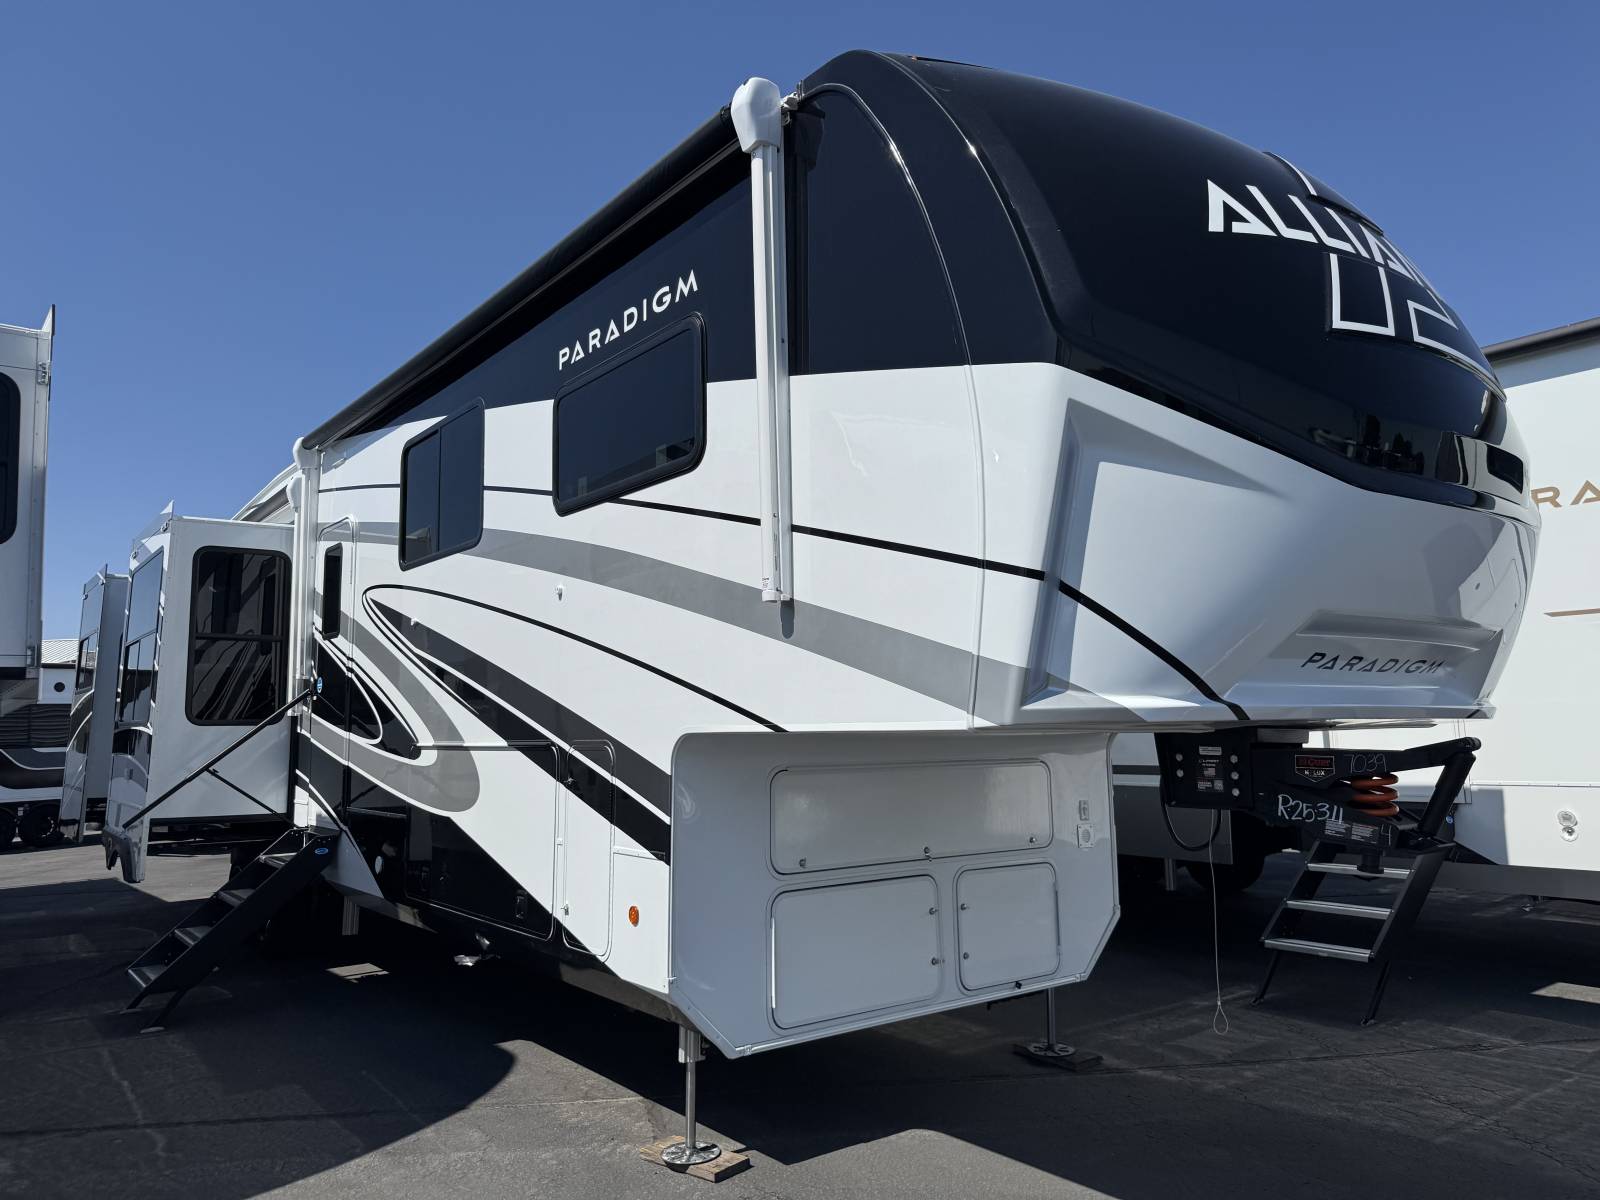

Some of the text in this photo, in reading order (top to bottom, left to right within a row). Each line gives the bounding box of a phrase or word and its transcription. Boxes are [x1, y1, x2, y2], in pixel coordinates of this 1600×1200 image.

[558, 269, 699, 371] PARADIGM
[1301, 652, 1446, 674] PARADIGM
[1344, 752, 1387, 774] 7039
